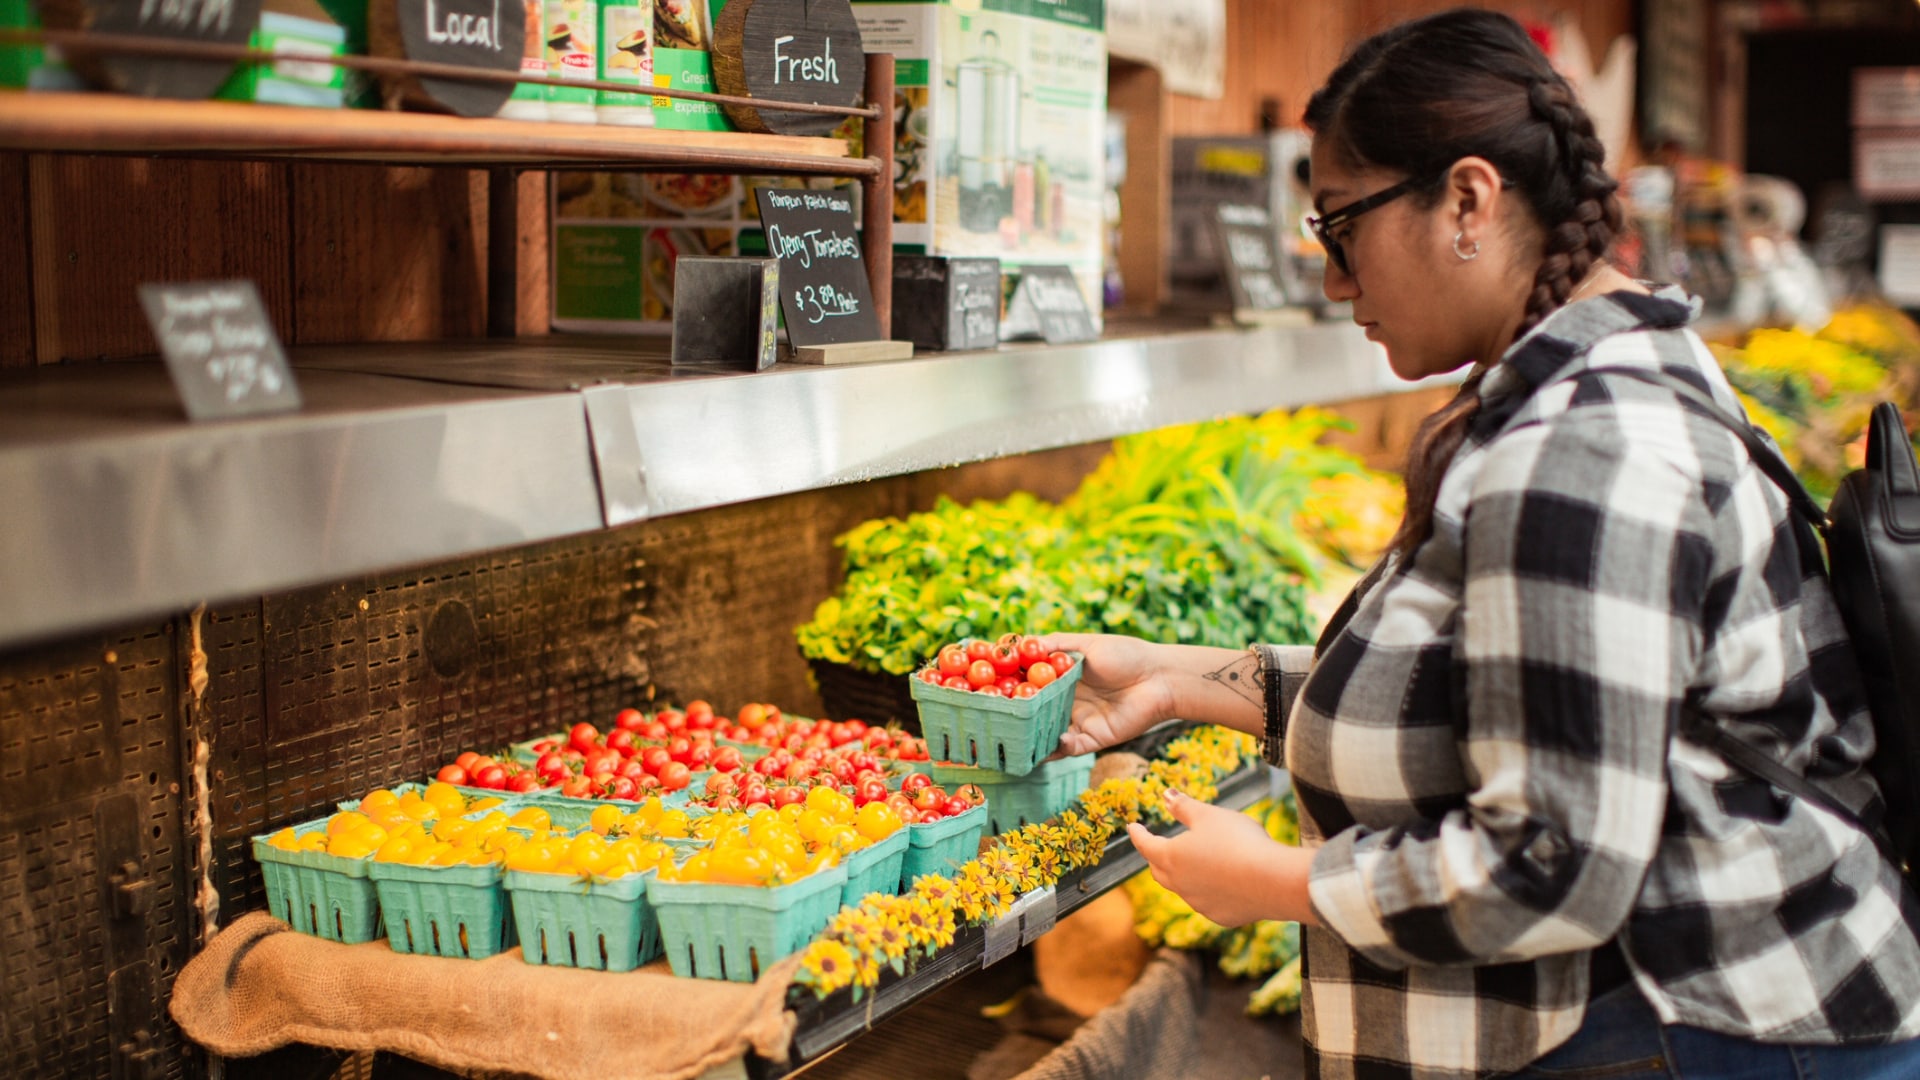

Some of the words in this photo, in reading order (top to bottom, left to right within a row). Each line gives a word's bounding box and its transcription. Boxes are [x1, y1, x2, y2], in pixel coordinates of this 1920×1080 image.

[426, 0, 502, 51] Local
[681, 70, 710, 84] Great
[774, 35, 840, 84] Fresh
[770, 224, 810, 268] Cherry
[803, 229, 860, 259] Tomatoes
